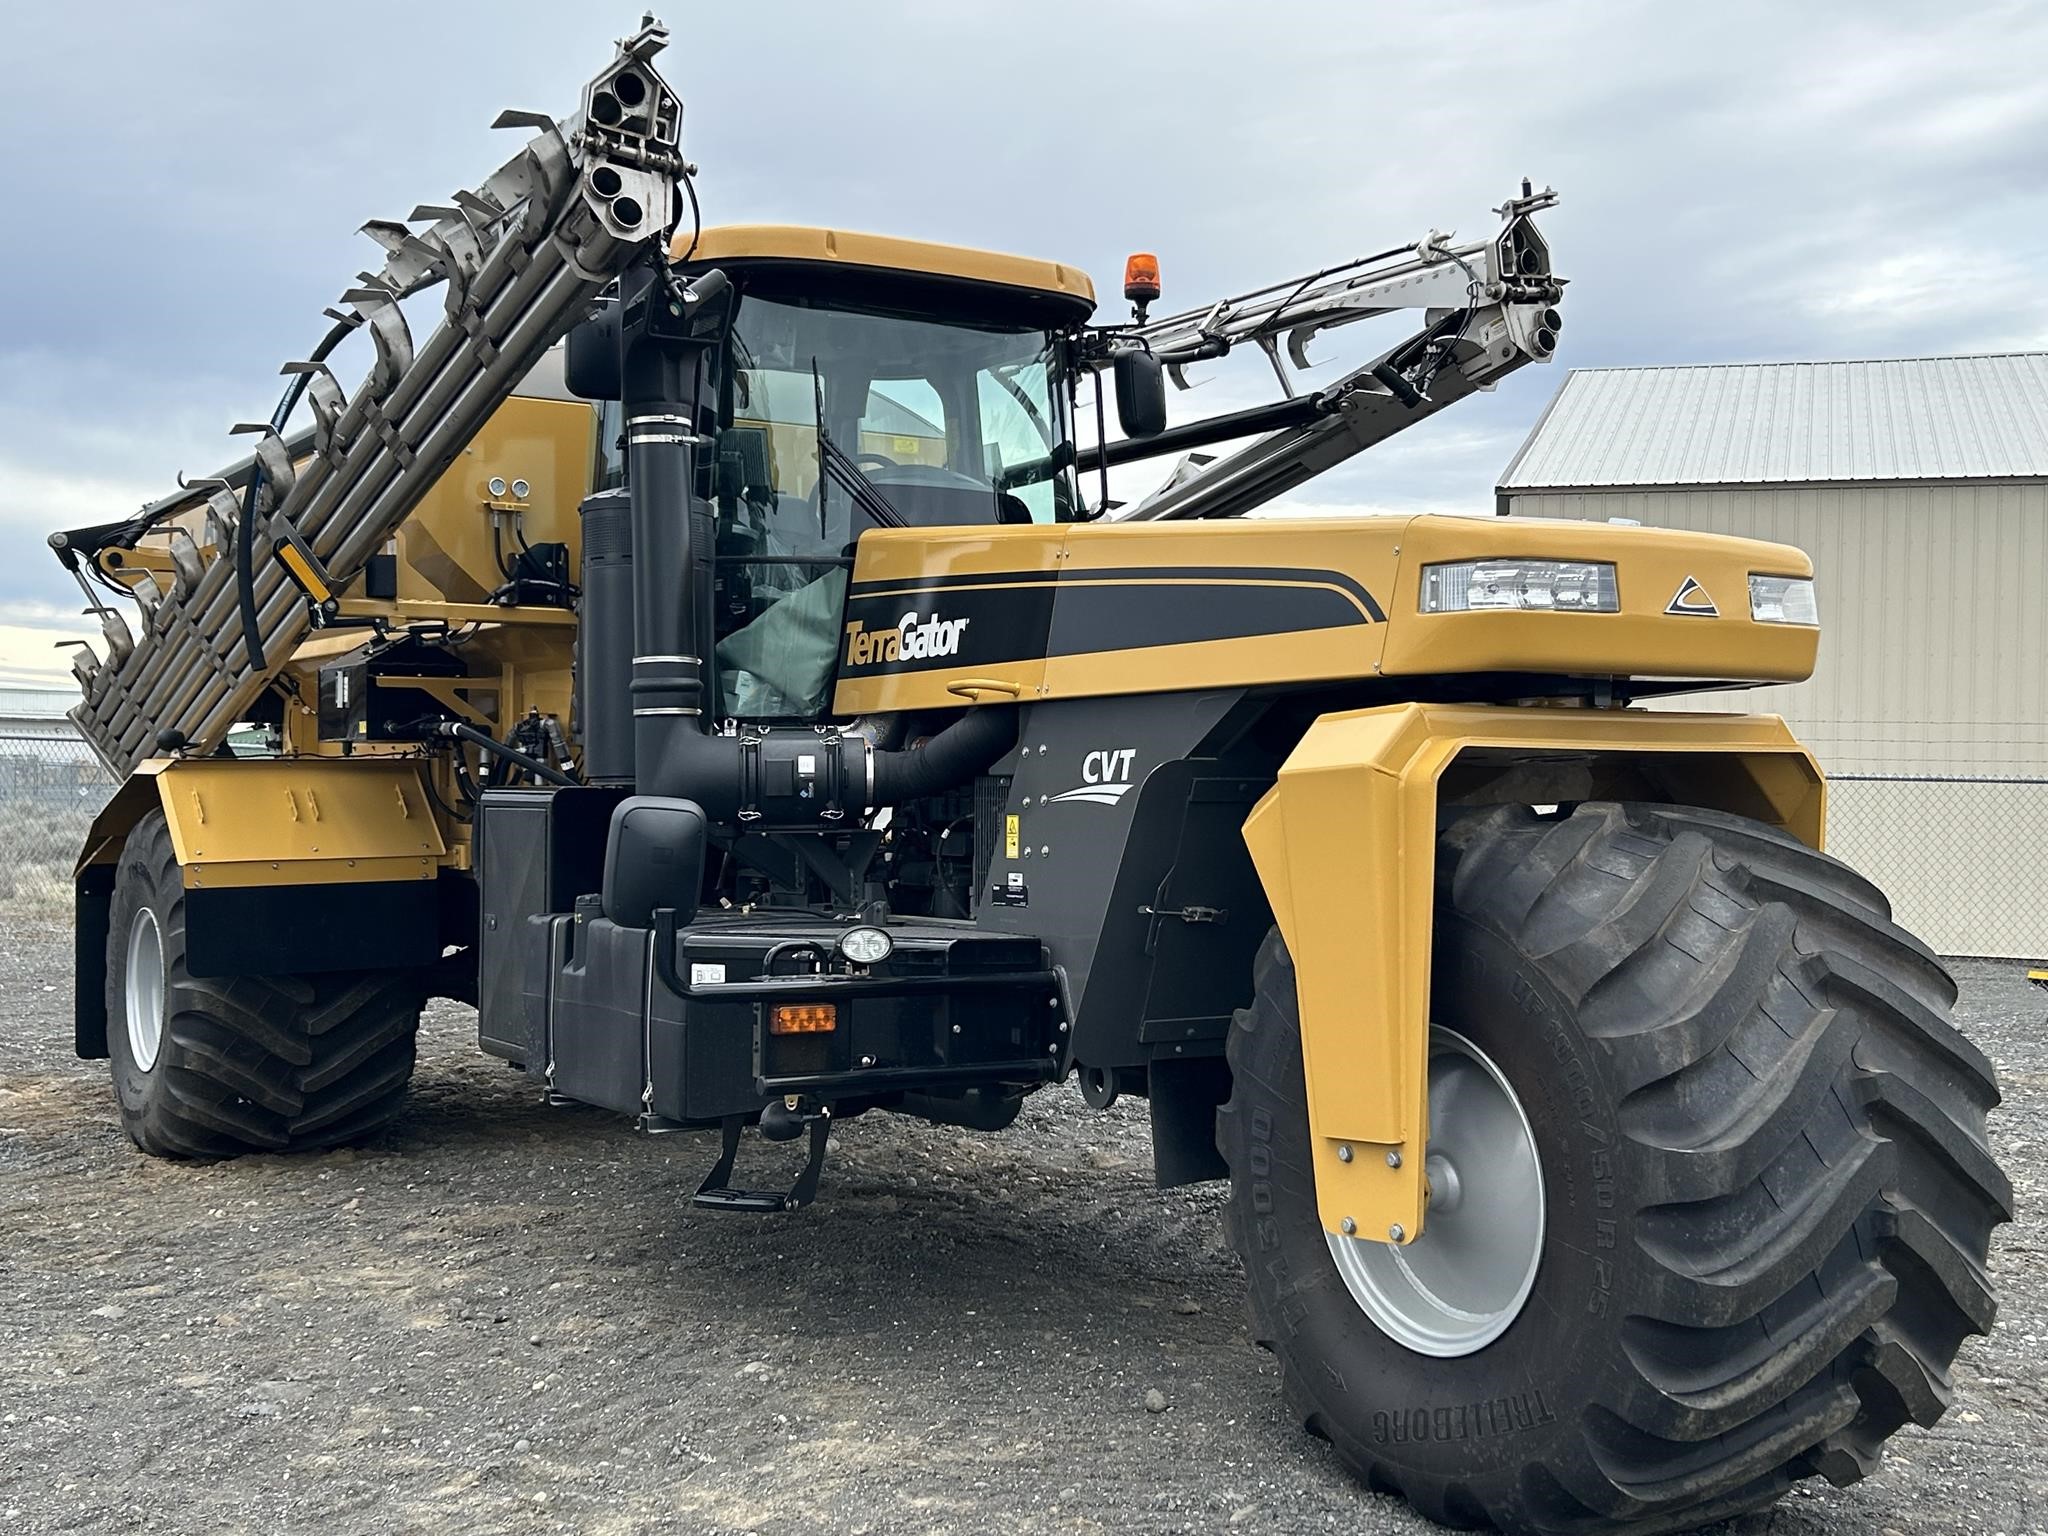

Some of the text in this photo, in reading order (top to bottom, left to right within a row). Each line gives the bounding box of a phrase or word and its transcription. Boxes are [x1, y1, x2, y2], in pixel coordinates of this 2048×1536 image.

[846, 611, 968, 666] TerraGator
[1082, 748, 1137, 784] CVT
[1373, 1388, 1557, 1446] TRELLEBORG
